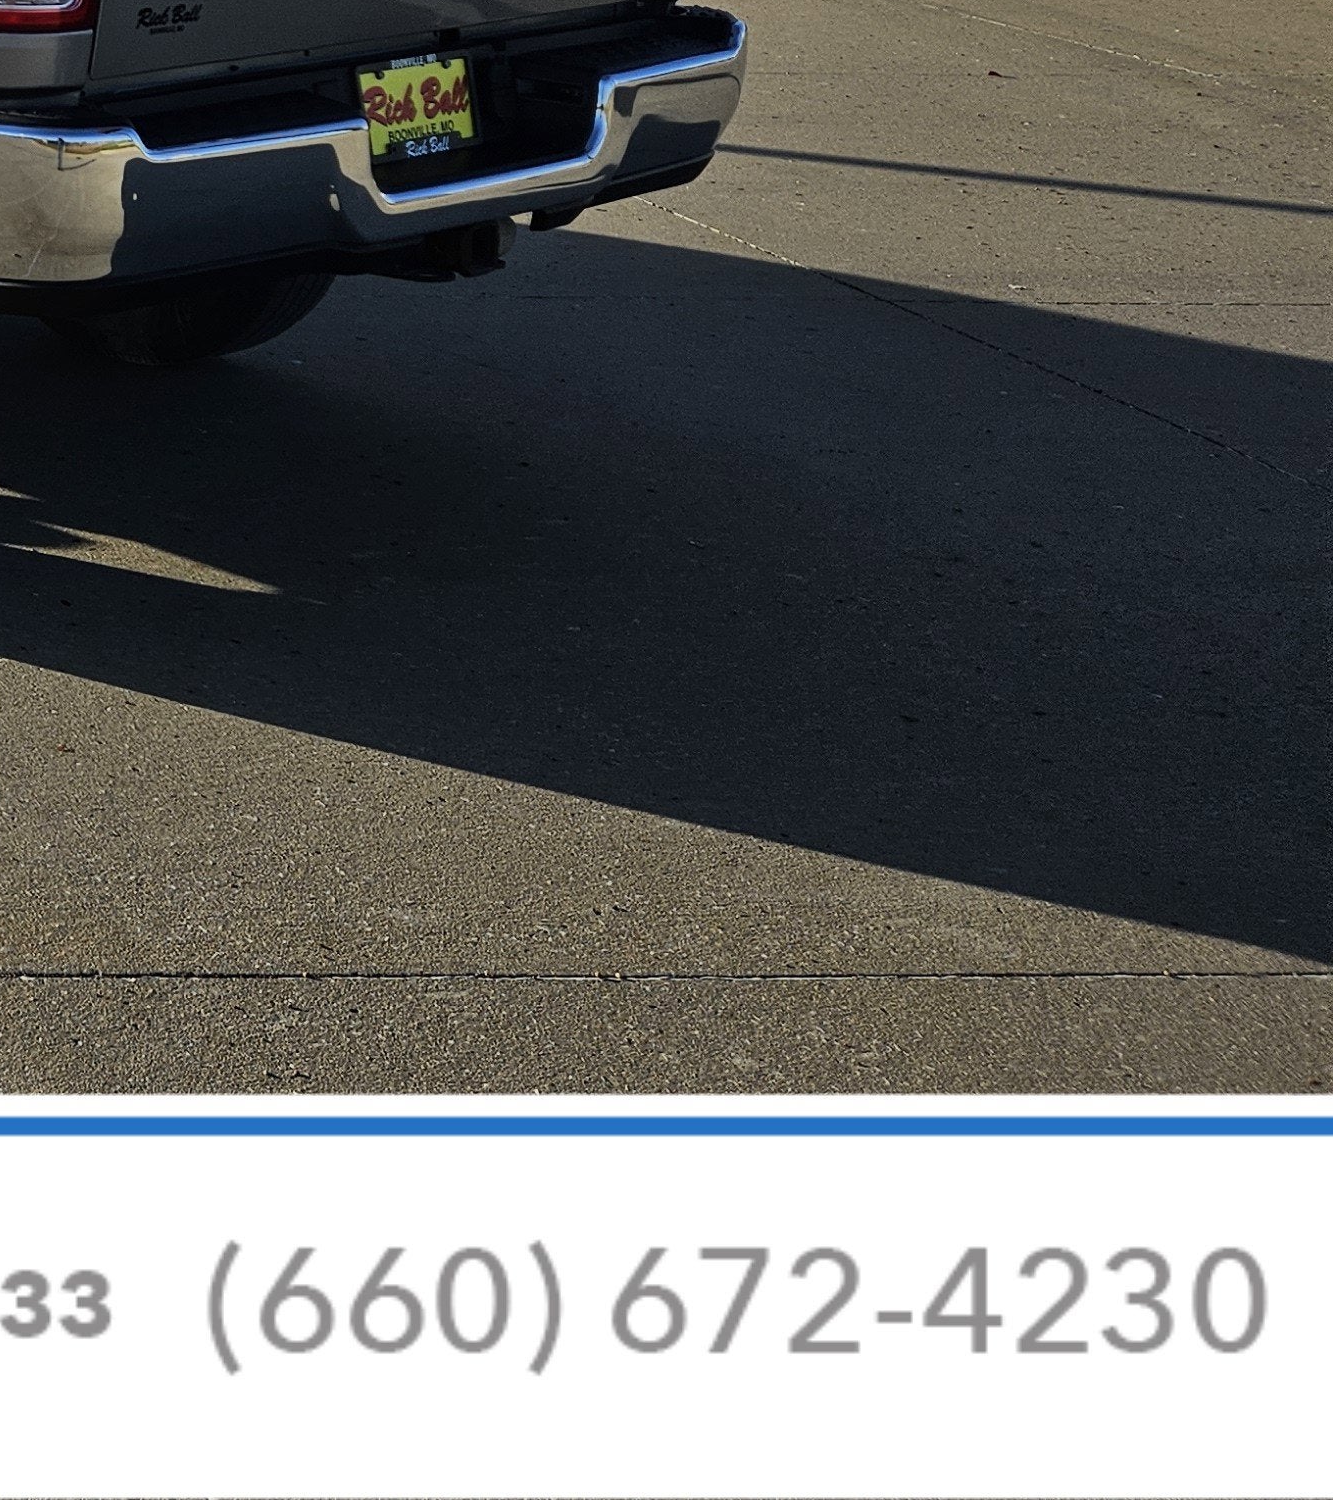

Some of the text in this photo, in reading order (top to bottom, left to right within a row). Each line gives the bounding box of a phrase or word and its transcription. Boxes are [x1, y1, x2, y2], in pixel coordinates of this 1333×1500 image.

[135, 3, 203, 29] Rick Ball
[363, 74, 469, 127] Rick Ball
[405, 135, 449, 158] Rick Ball
